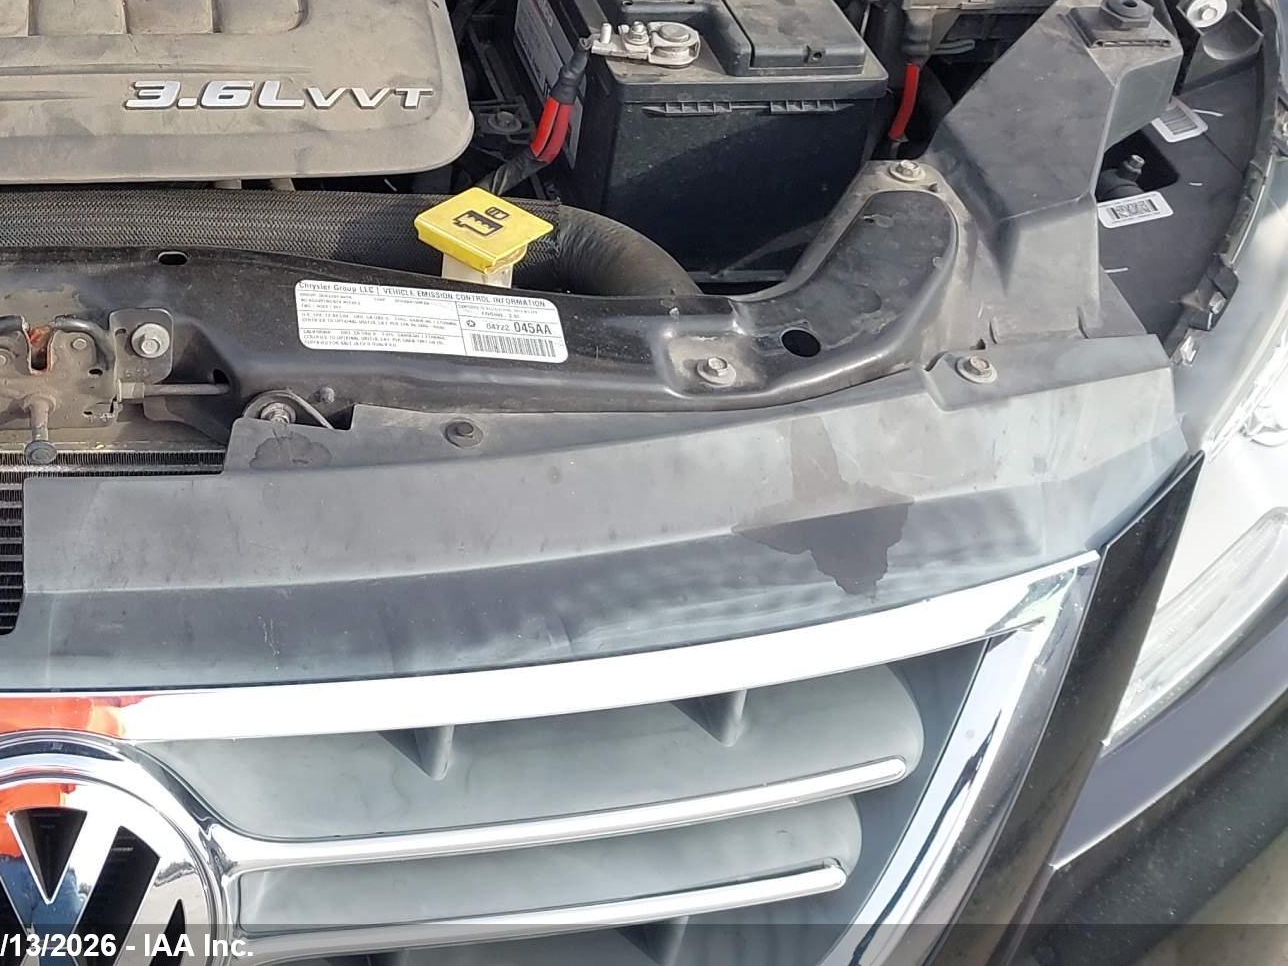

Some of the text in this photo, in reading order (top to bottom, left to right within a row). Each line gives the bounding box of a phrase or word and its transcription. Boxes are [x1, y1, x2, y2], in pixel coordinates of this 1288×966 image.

[299, 282, 546, 307] Chrysler Group LLC VEHICLE EMISSION CONTROL INFORMATION
[513, 321, 552, 335] 045AA
